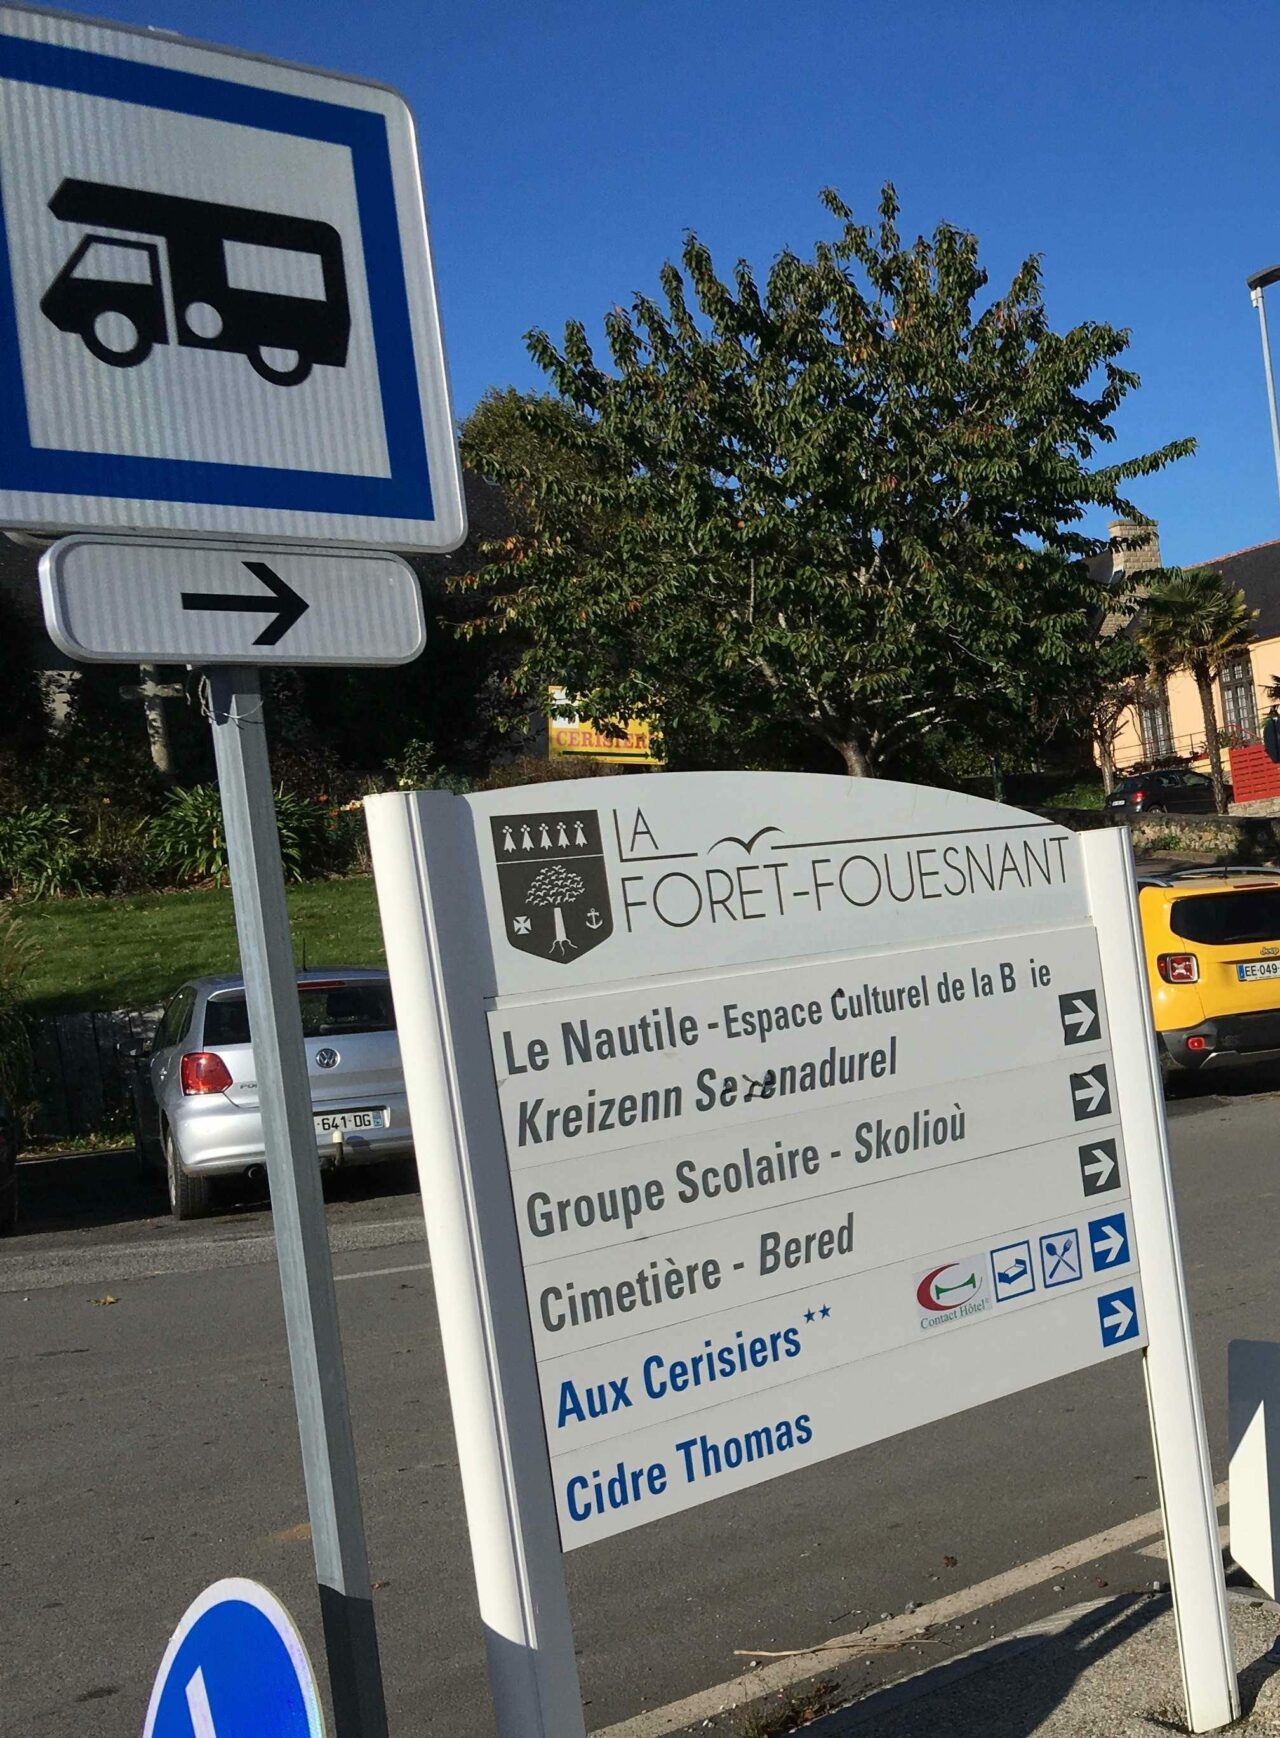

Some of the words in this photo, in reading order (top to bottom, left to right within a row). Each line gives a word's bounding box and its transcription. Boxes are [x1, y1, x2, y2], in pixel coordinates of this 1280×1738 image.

[613, 806, 685, 862] LA
[503, 1031, 549, 1075] Le
[561, 1006, 699, 1066] Nautile
[830, 975, 930, 1021] Culturel
[937, 971, 965, 1004] de
[971, 967, 994, 999] la
[517, 1084, 683, 1148] Kreizenn
[526, 1176, 666, 1239] Groupe
[677, 1138, 821, 1205] Scolaire
[855, 1103, 967, 1165] Skolioù
[539, 1255, 722, 1333] Cimetière
[758, 1211, 856, 1277] Bered
[920, 1311, 957, 1329] Contact
[556, 1374, 633, 1429] Aux
[643, 1323, 802, 1400] Cerisiers
[566, 1460, 668, 1522] Cidre
[675, 1412, 813, 1485] Thomas
